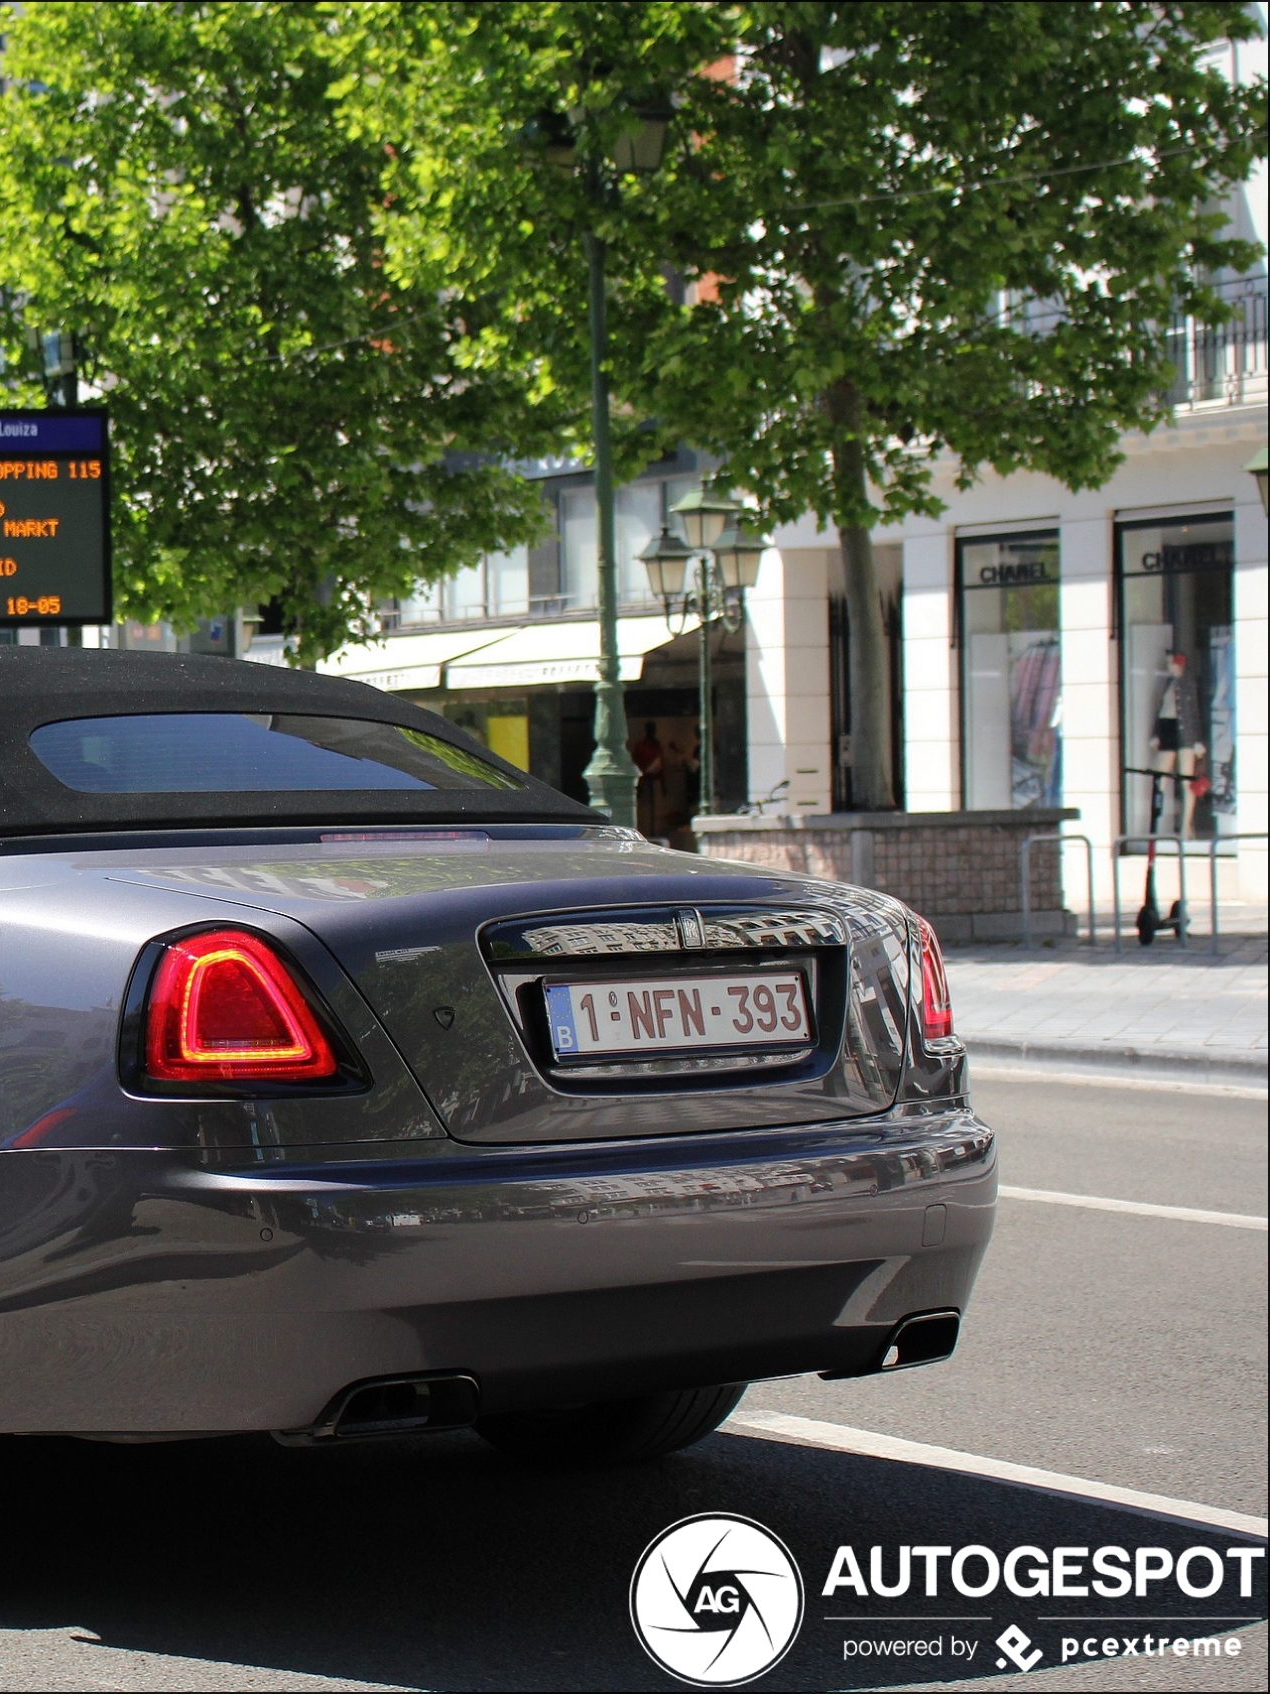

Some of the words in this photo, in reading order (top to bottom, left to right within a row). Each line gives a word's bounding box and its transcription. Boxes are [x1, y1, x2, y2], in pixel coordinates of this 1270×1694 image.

[69, 460, 101, 479] 115
[4, 518, 59, 537] MARKT
[980, 562, 1048, 583] CHANEL
[7, 596, 61, 615] 18-05
[557, 1025, 574, 1048] B
